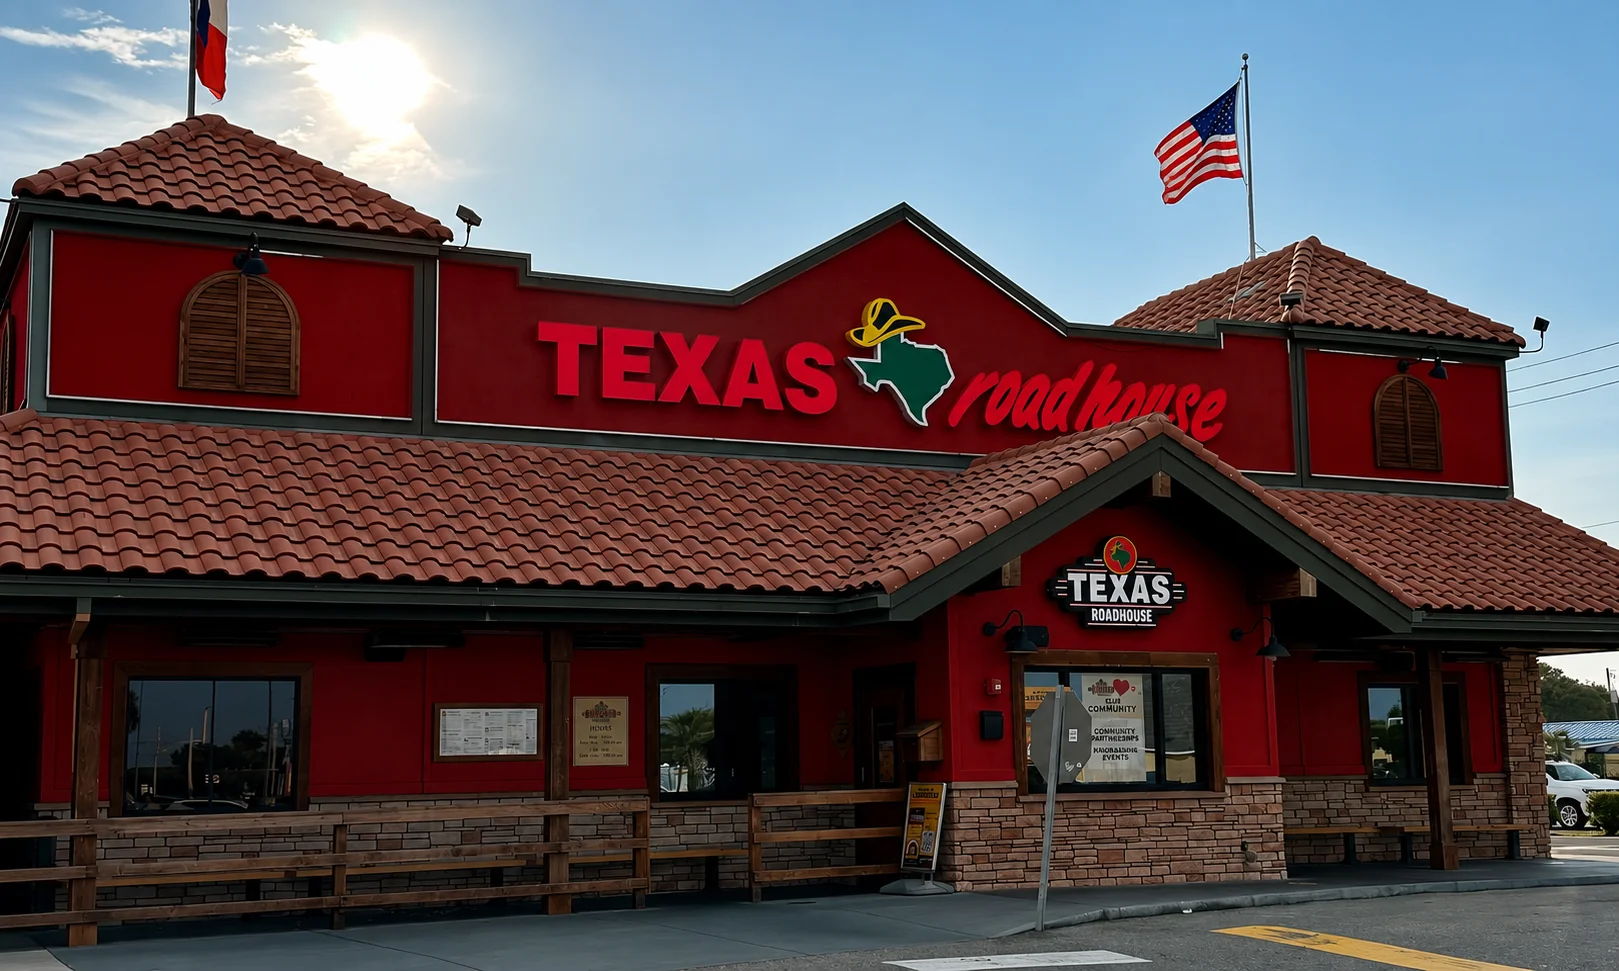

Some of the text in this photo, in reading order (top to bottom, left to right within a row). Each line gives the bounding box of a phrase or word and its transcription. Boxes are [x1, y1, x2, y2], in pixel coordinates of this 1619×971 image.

[538, 321, 838, 415] TEXAS
[1067, 572, 1171, 605] TEXAS
[1091, 607, 1153, 623] ROADHOUSE
[1088, 705, 1137, 713] COMMUNITY
